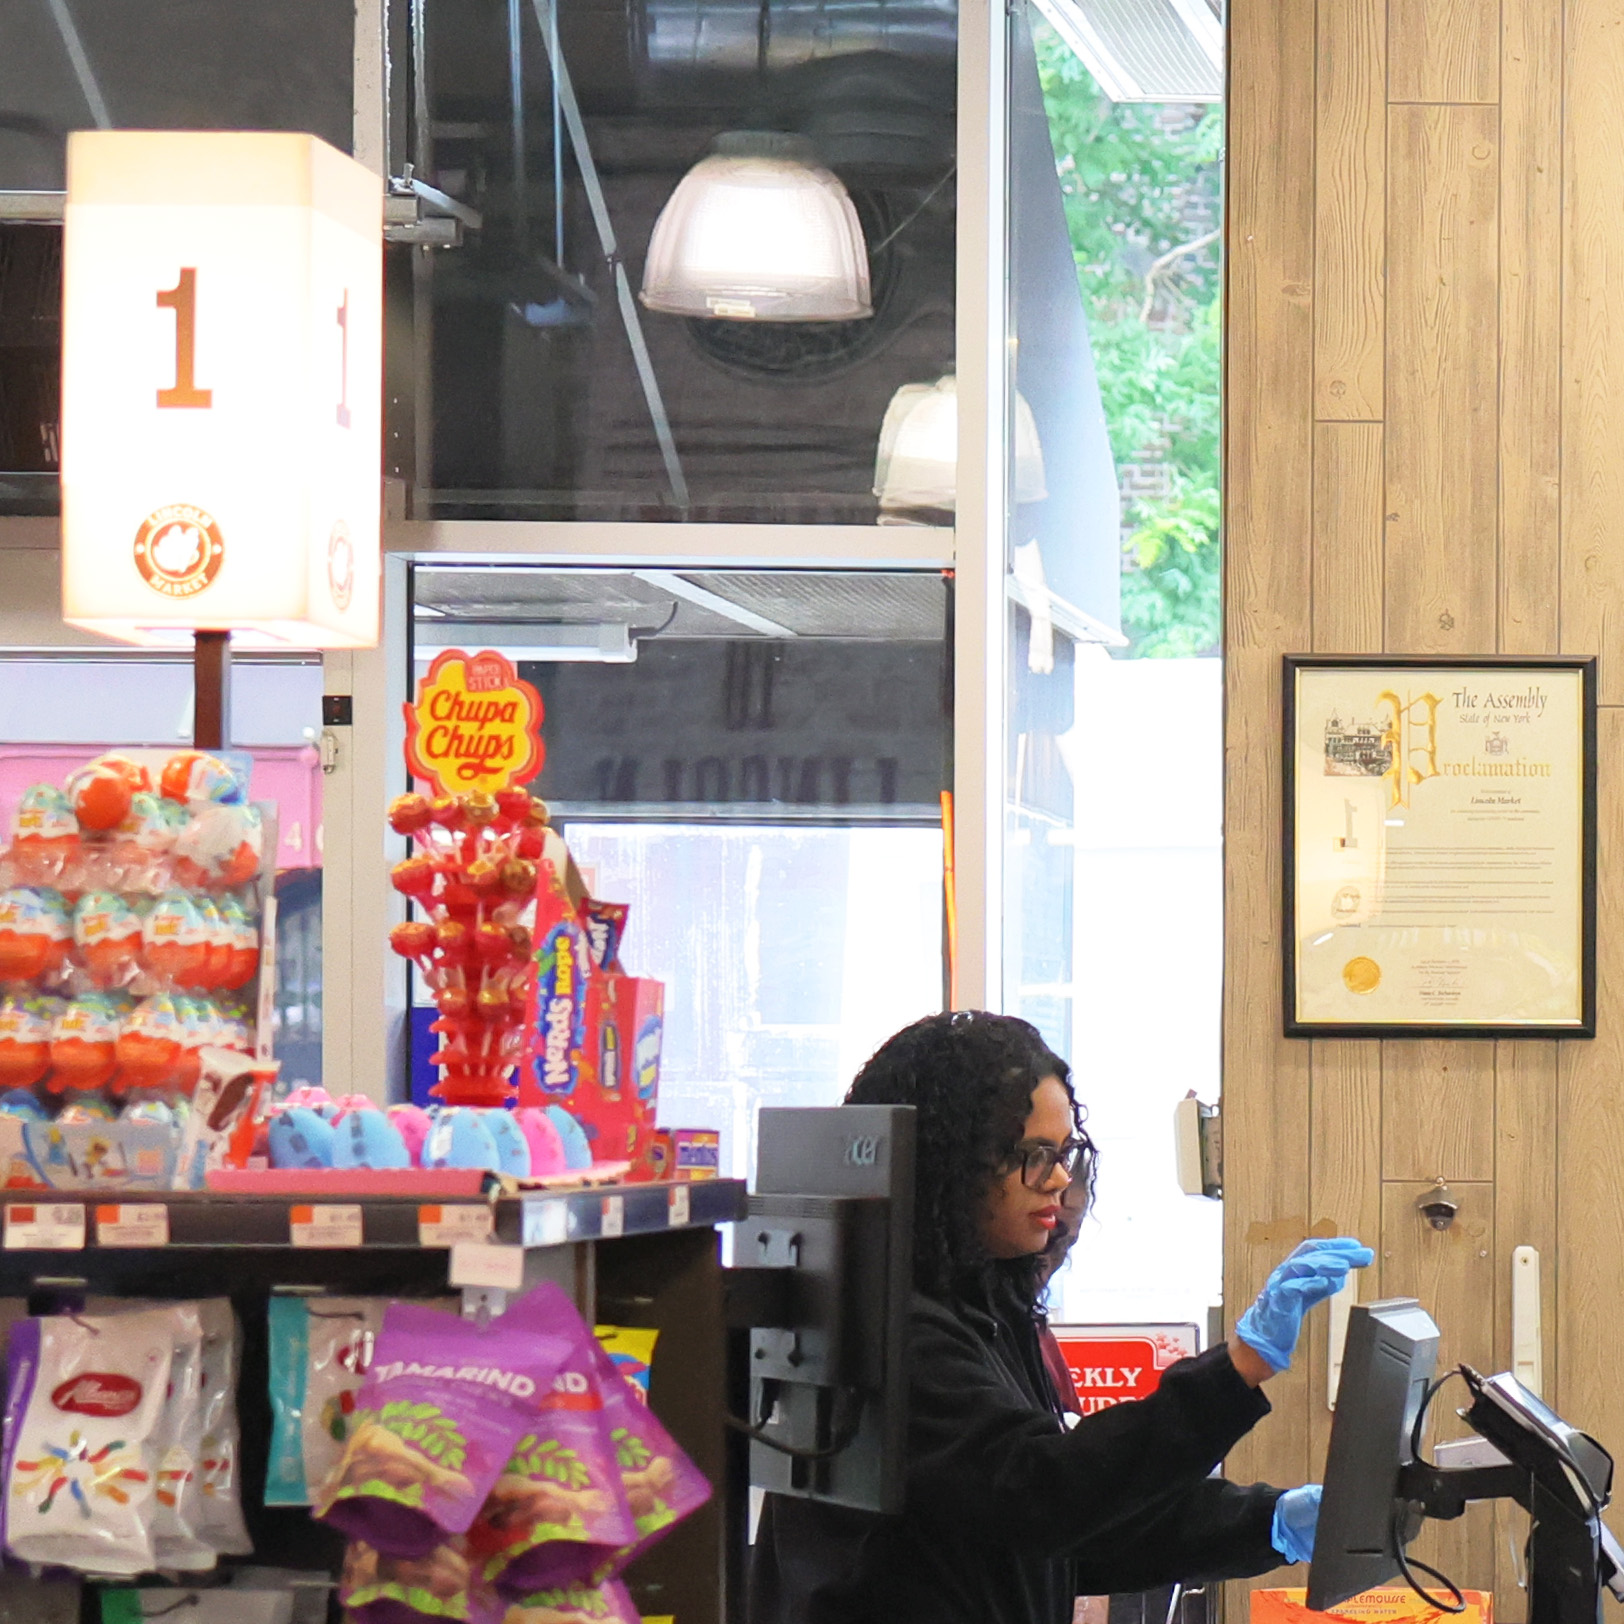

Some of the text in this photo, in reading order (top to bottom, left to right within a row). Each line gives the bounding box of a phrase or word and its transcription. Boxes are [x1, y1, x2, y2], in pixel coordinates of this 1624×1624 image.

[155, 266, 213, 409] 1
[430, 688, 520, 730] Chupa
[1452, 686, 1548, 718] The Assembly
[1459, 713, 1480, 724] State
[1493, 714, 1511, 724] New
[1514, 711, 1531, 724] York
[425, 724, 516, 772] Chups
[374, 1360, 537, 1398] TAMARIND
[1068, 1367, 1142, 1387] EKLY
